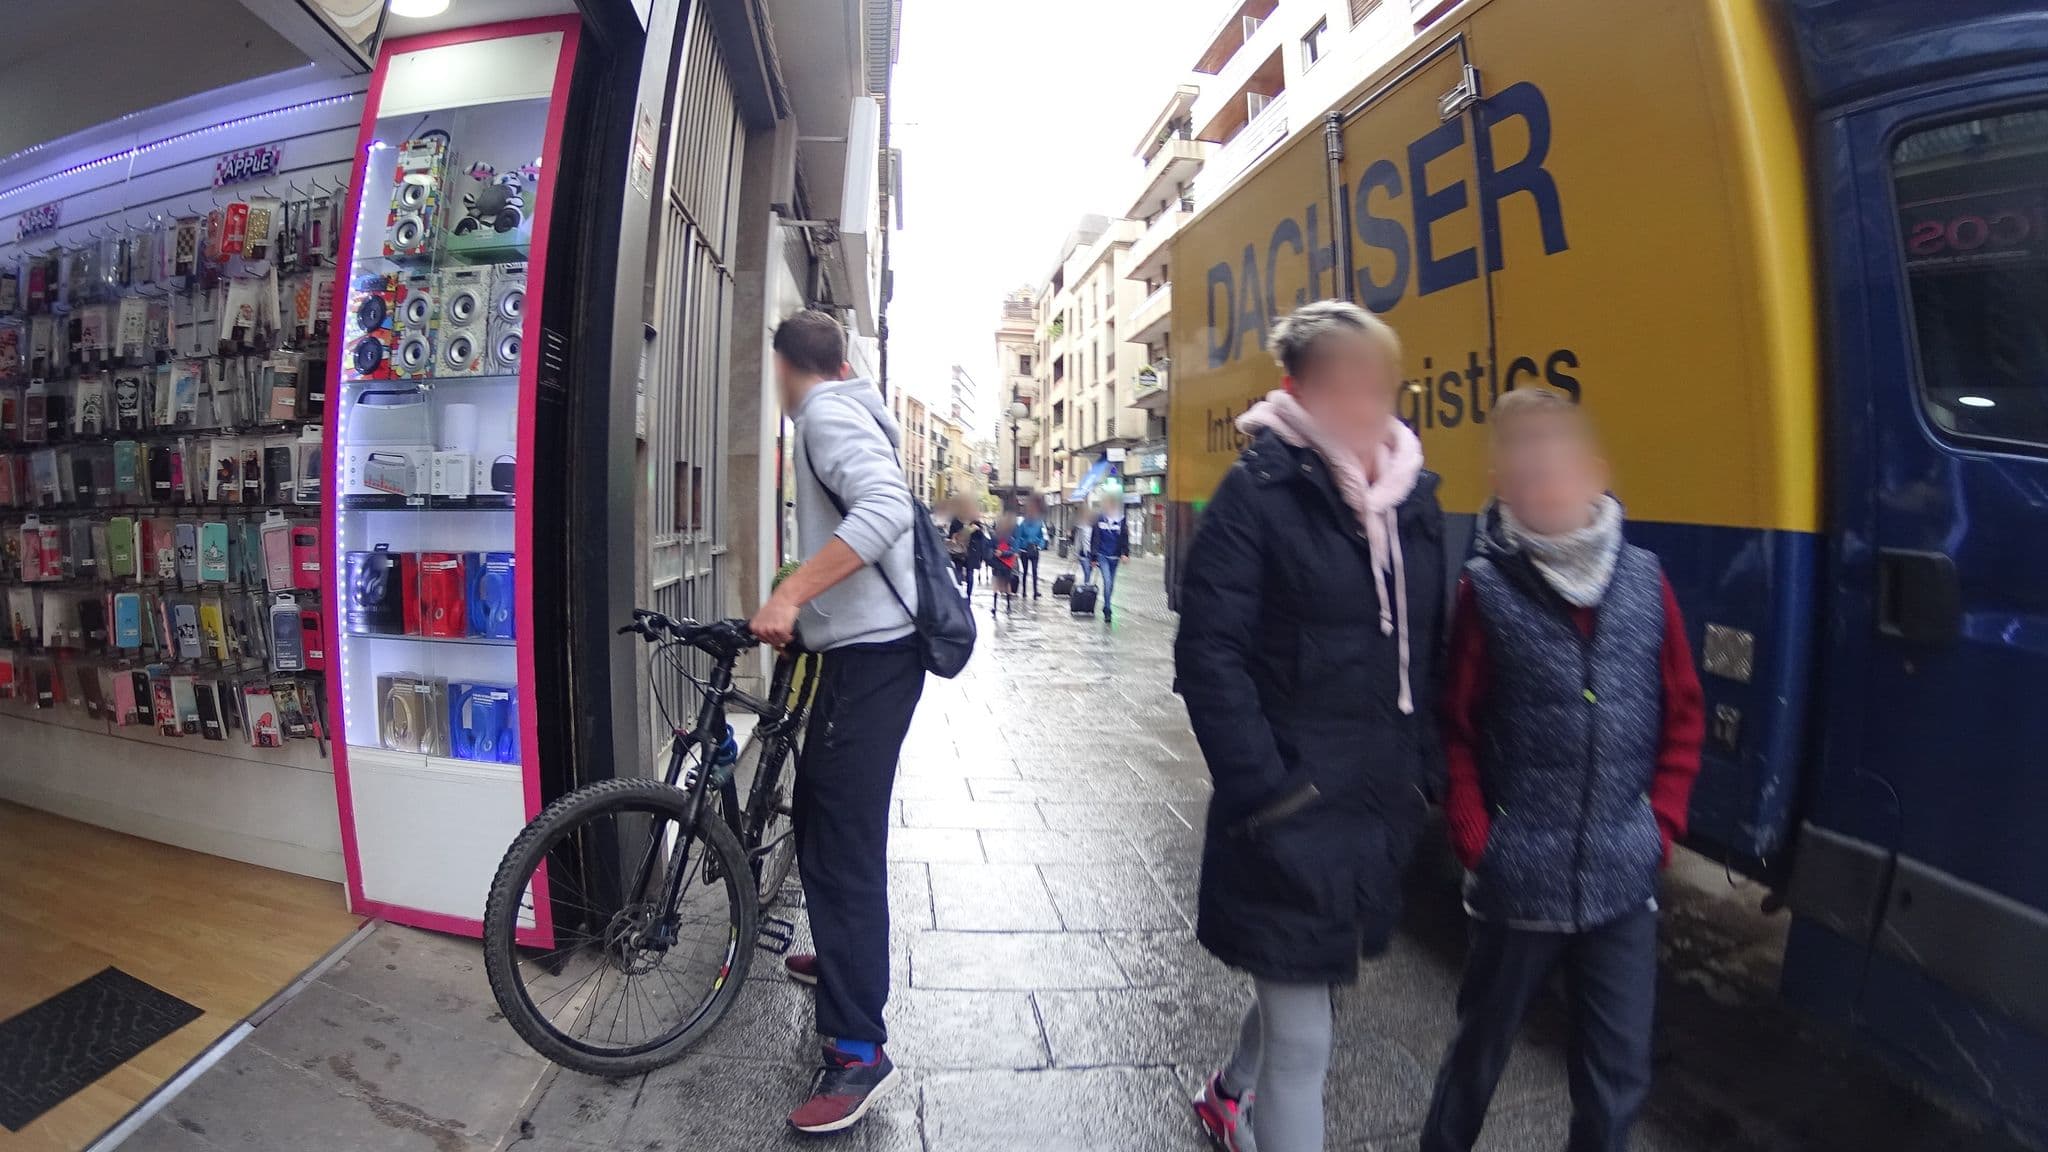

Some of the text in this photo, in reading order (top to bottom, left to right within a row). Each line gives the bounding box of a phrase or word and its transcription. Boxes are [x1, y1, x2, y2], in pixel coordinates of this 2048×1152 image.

[223, 152, 271, 179] APPLE
[1207, 81, 1569, 368] DACHSER
[1396, 349, 1581, 437] gistics
